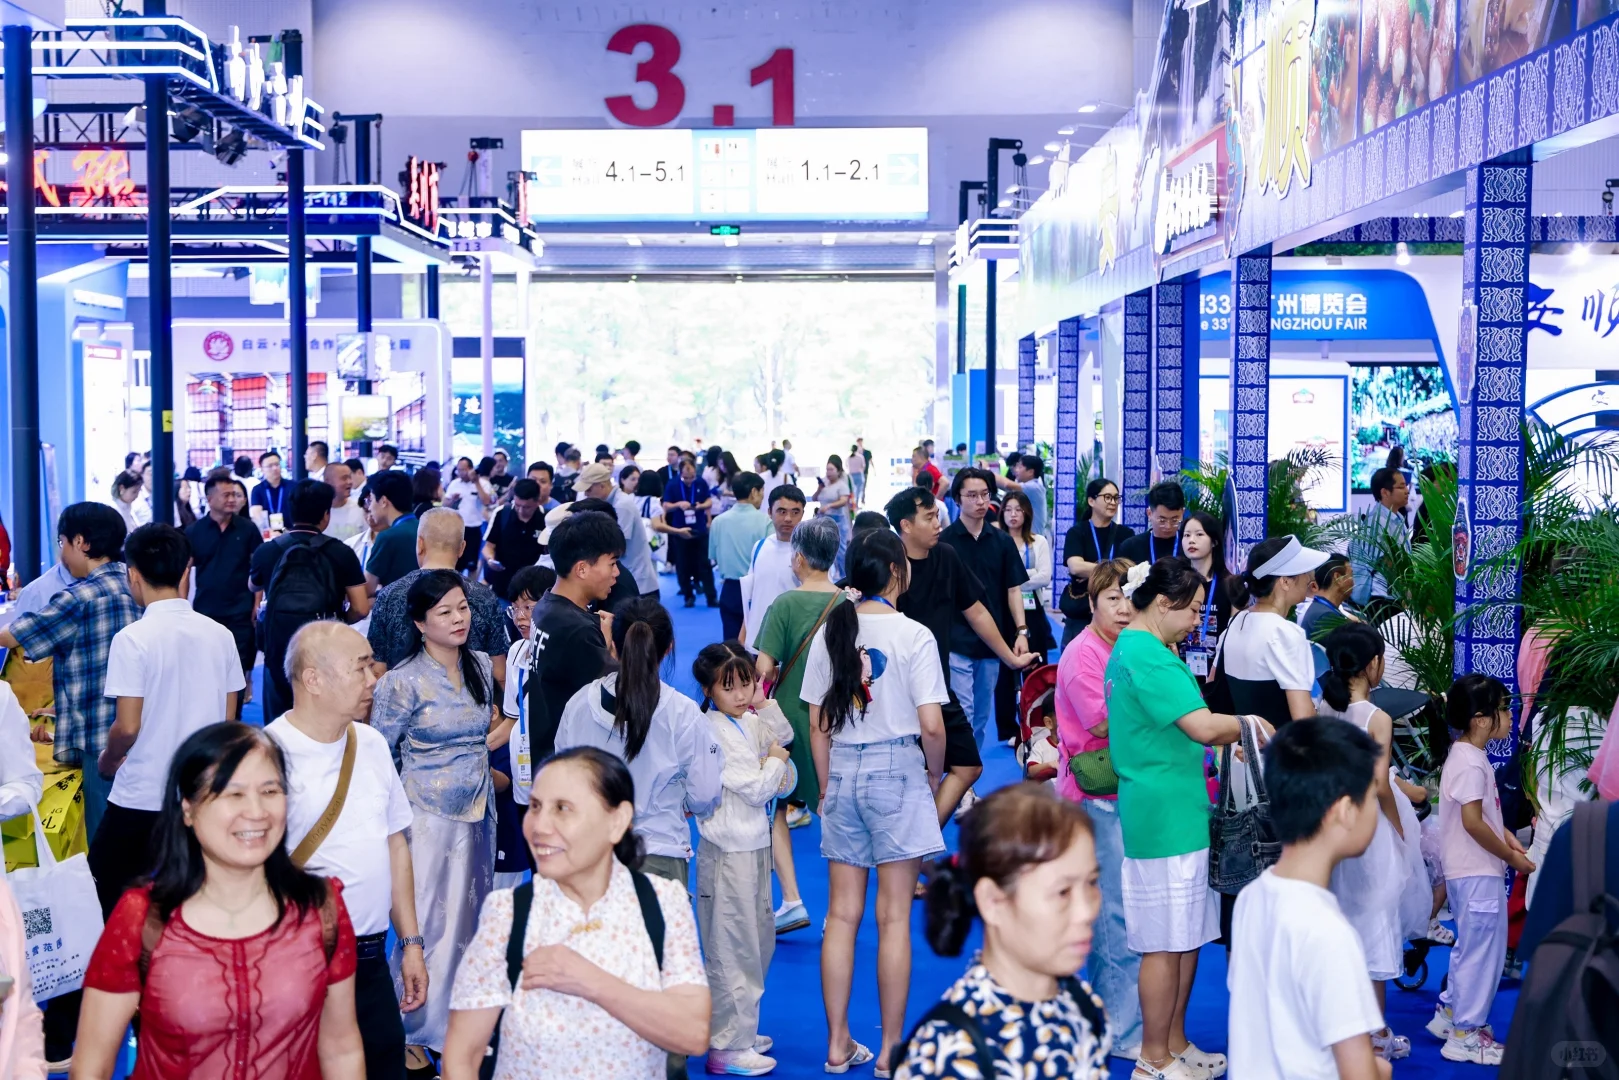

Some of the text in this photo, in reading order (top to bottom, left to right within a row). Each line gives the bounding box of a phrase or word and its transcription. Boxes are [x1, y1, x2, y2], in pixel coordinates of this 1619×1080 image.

[604, 24, 794, 127] 3.1
[1271, 318, 1332, 330] NGZHOU
[1336, 318, 1367, 330] FAIR
